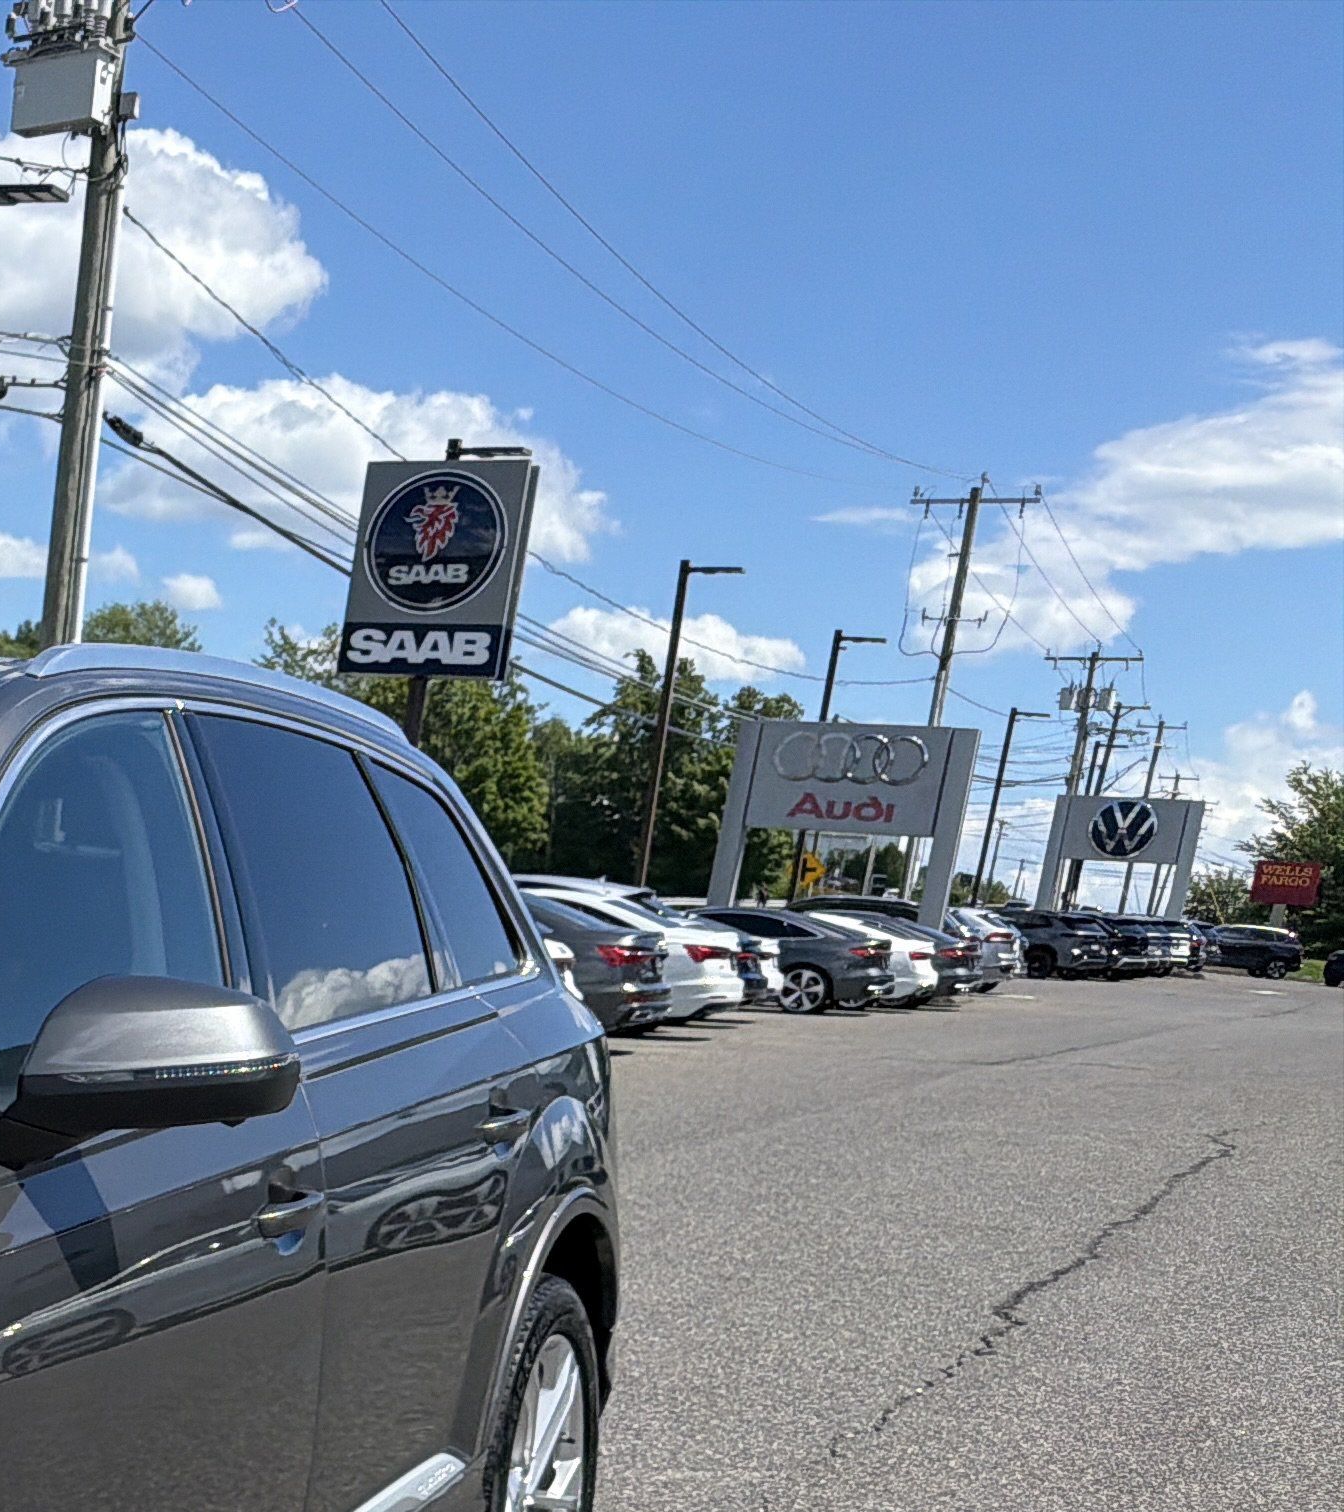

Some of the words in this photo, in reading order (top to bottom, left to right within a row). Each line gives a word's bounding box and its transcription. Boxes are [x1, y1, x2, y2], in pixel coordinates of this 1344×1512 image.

[387, 563, 470, 586] SAAB
[346, 628, 492, 666] SAAB
[786, 791, 896, 824] Audi
[1260, 874, 1310, 887] FARGO
[1262, 864, 1313, 877] WELLS
